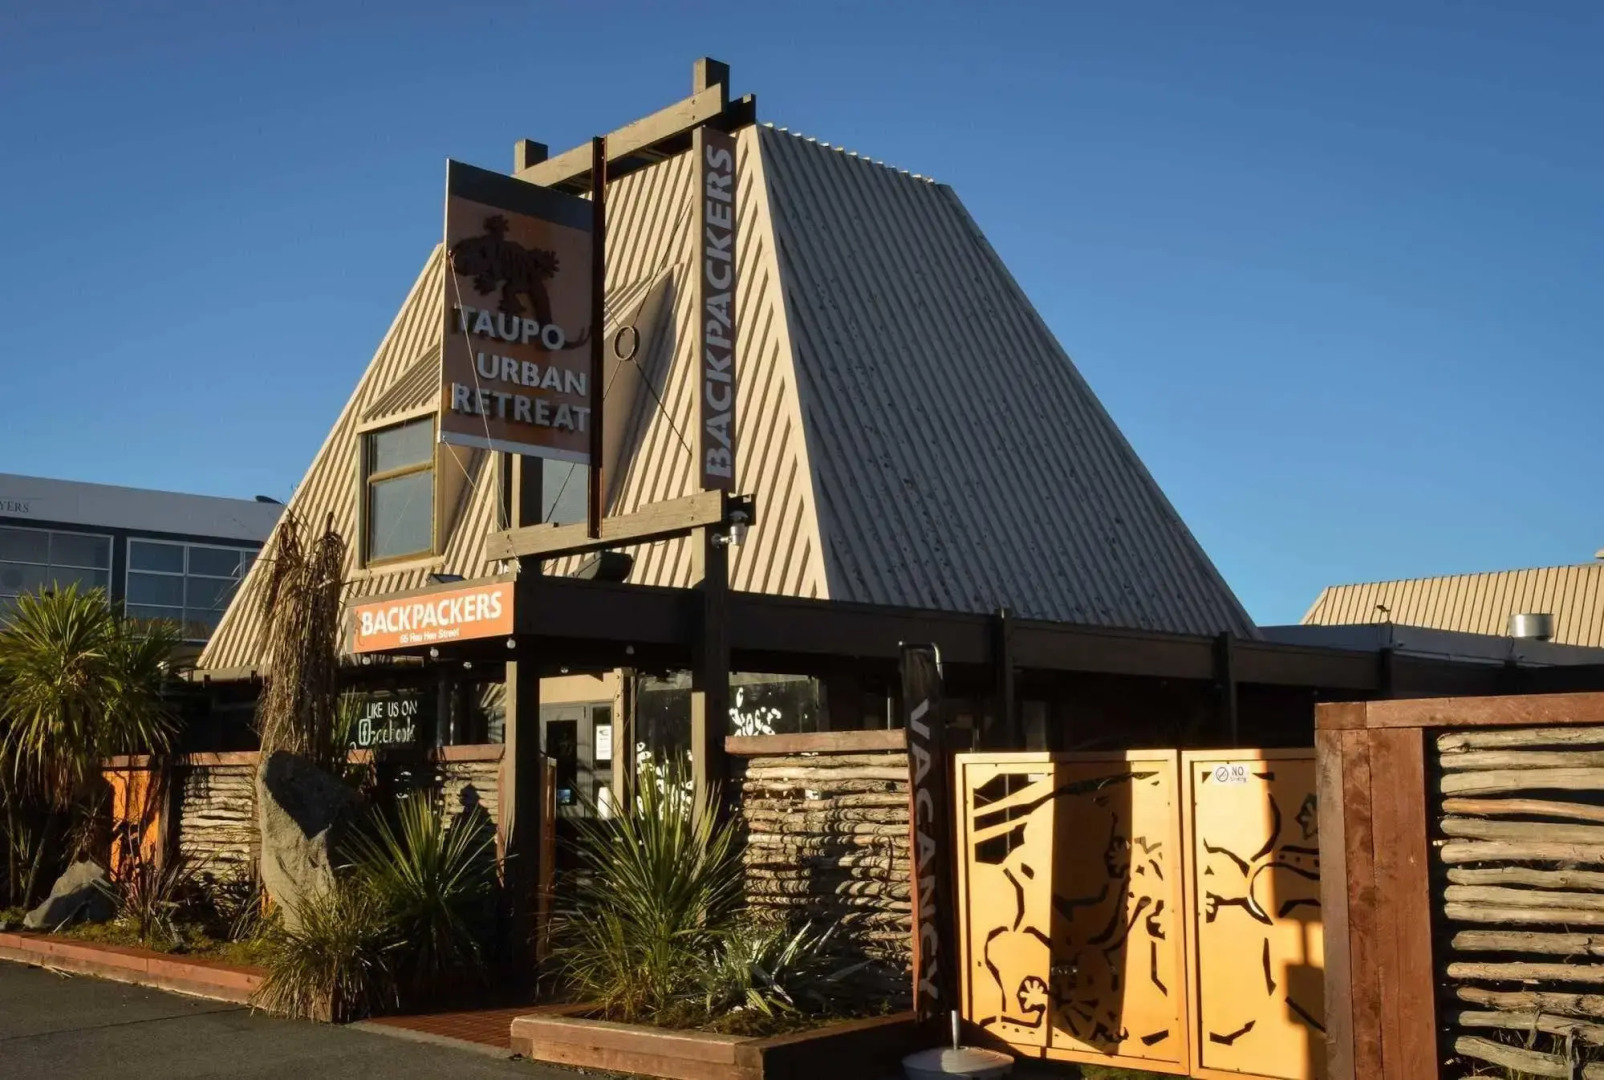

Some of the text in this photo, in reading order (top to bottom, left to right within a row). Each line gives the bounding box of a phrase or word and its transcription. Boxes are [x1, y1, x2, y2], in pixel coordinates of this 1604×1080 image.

[453, 303, 566, 351] TAUPO
[706, 144, 733, 479] BACKPACKERS
[476, 353, 587, 397] URBAN
[451, 382, 591, 432] RETREAT
[361, 591, 503, 637] BACKPACKERS
[366, 700, 418, 719] LIKE US ON
[1231, 766, 1244, 776] NO
[909, 698, 940, 1000] VACANCY
